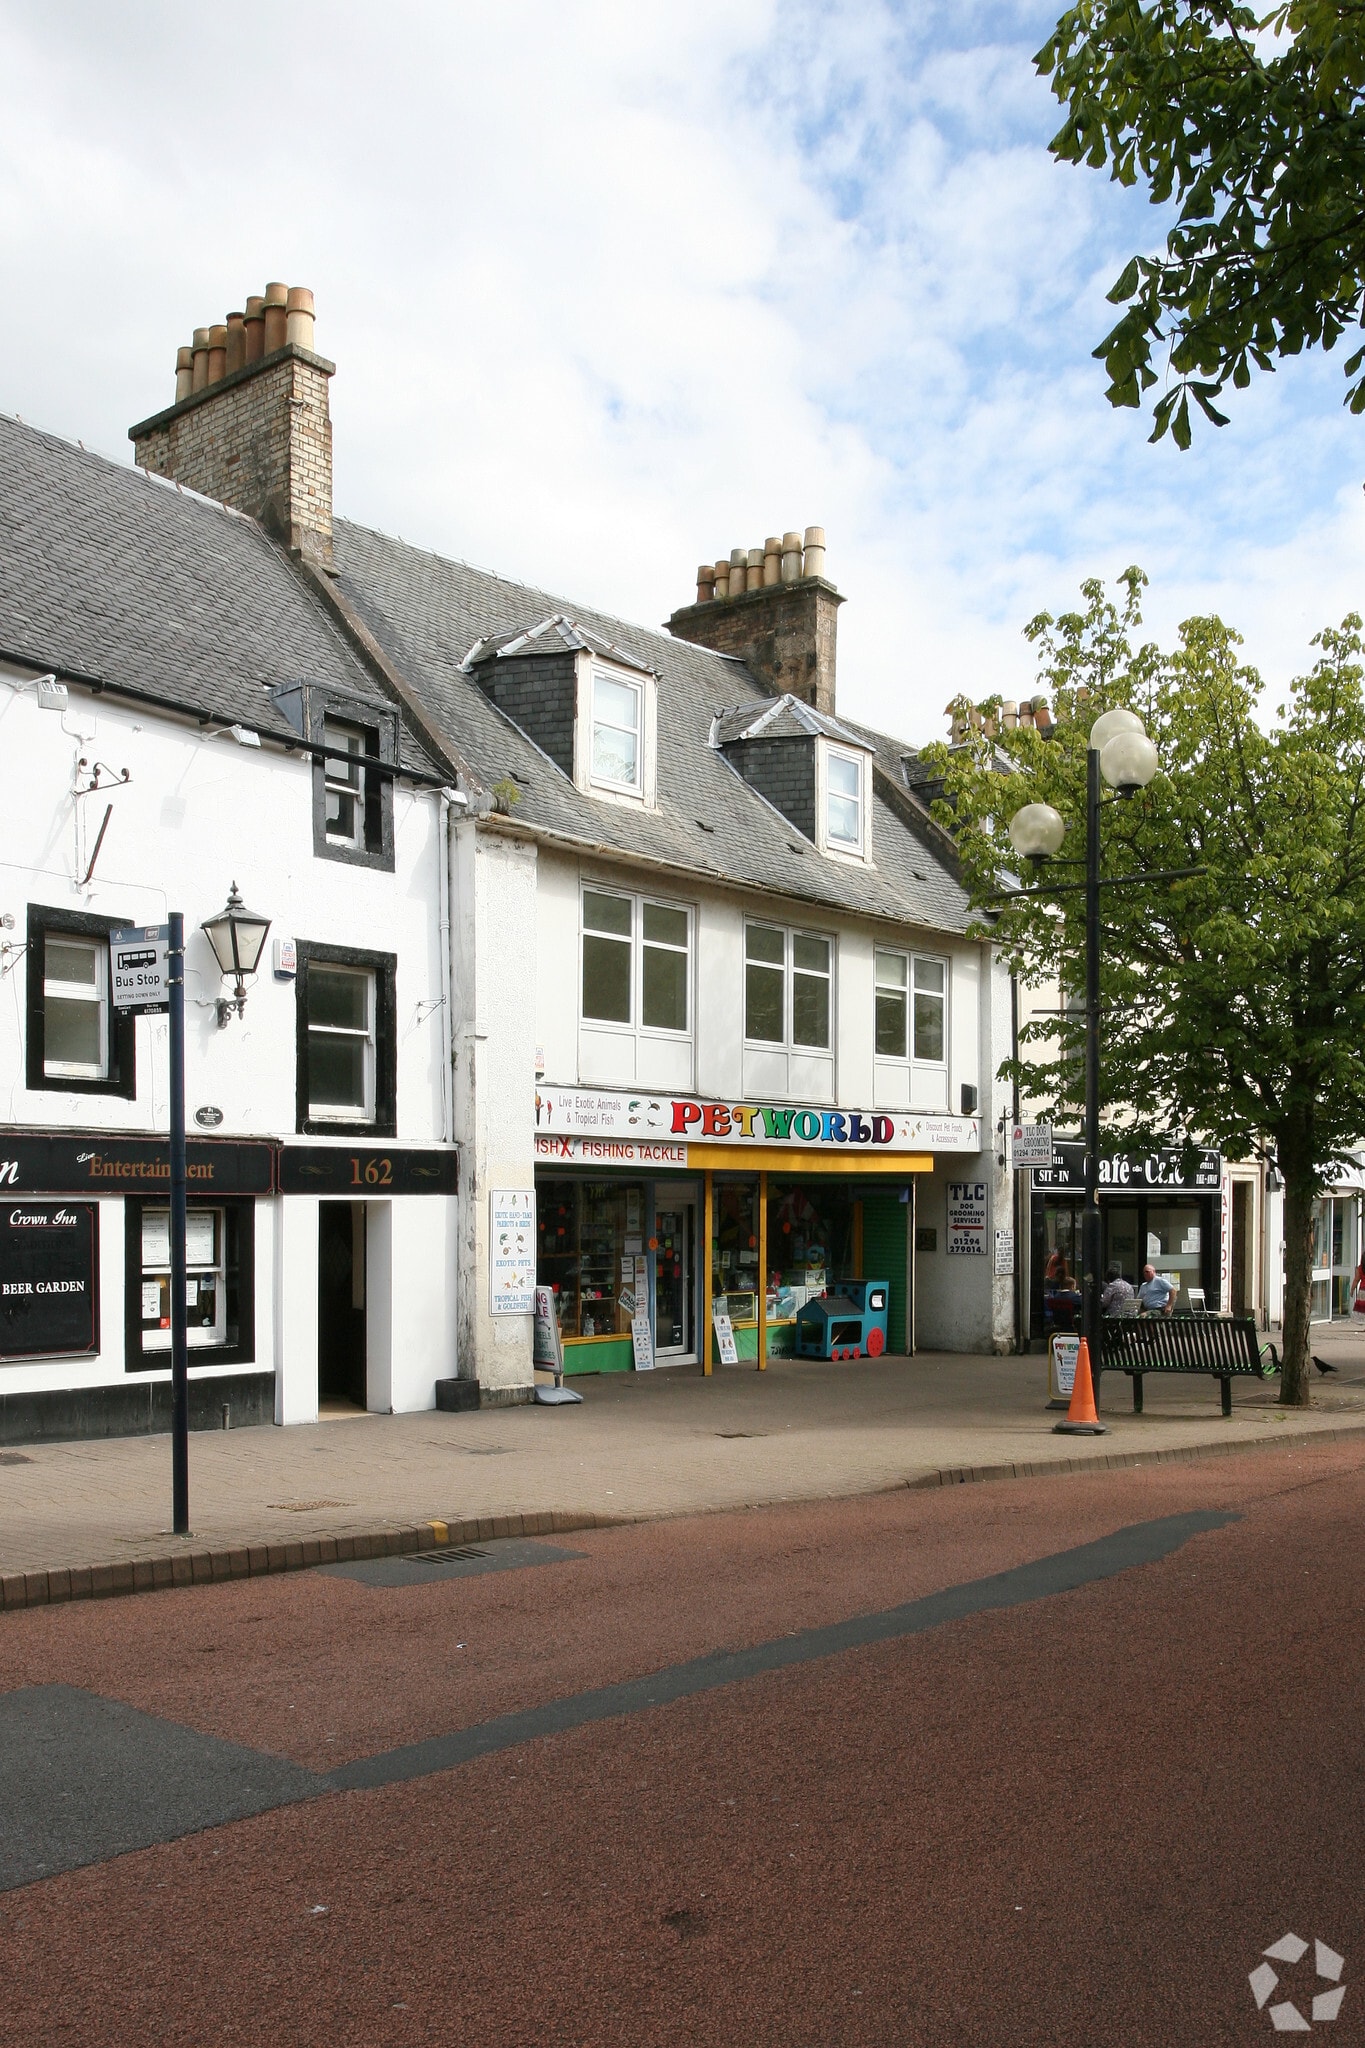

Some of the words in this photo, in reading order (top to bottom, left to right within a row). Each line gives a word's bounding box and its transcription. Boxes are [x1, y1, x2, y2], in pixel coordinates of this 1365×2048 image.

[116, 976, 134, 988] Bus
[137, 973, 160, 986] Stop
[559, 1095, 572, 1108] Live
[575, 1096, 595, 1110] Exotic
[597, 1098, 622, 1111] Animals
[567, 1112, 571, 1123] &
[575, 1111, 598, 1126] Tropical
[602, 1114, 615, 1126] Fish
[926, 1121, 943, 1132] Discount
[951, 1123, 963, 1132] Foods
[1026, 1126, 1035, 1137] TLC
[1036, 1126, 1047, 1136] DOG
[936, 1133, 959, 1143] Accessories
[1024, 1137, 1050, 1147] GROOMING
[76, 1152, 96, 1163] Live
[582, 1141, 635, 1158] FISHING
[637, 1145, 685, 1161] TACKLE
[1014, 1149, 1029, 1157] 01294
[1031, 1148, 1050, 1156] 279014
[89, 1156, 215, 1179] Entertainent
[350, 1158, 393, 1184] 162
[1083, 1152, 1130, 1184] afé
[950, 1184, 985, 1201] TLC
[10, 1209, 48, 1226] Crown
[52, 1208, 78, 1226] Inn
[953, 1238, 980, 1246] 01294
[495, 1259, 517, 1267] EXOTIC
[2, 1283, 34, 1295] BEER
[36, 1280, 85, 1294] GARDEN
[494, 1294, 520, 1303] TROPICAL
[520, 1293, 532, 1302] FISH
[502, 1302, 528, 1310] GOLDFISH
